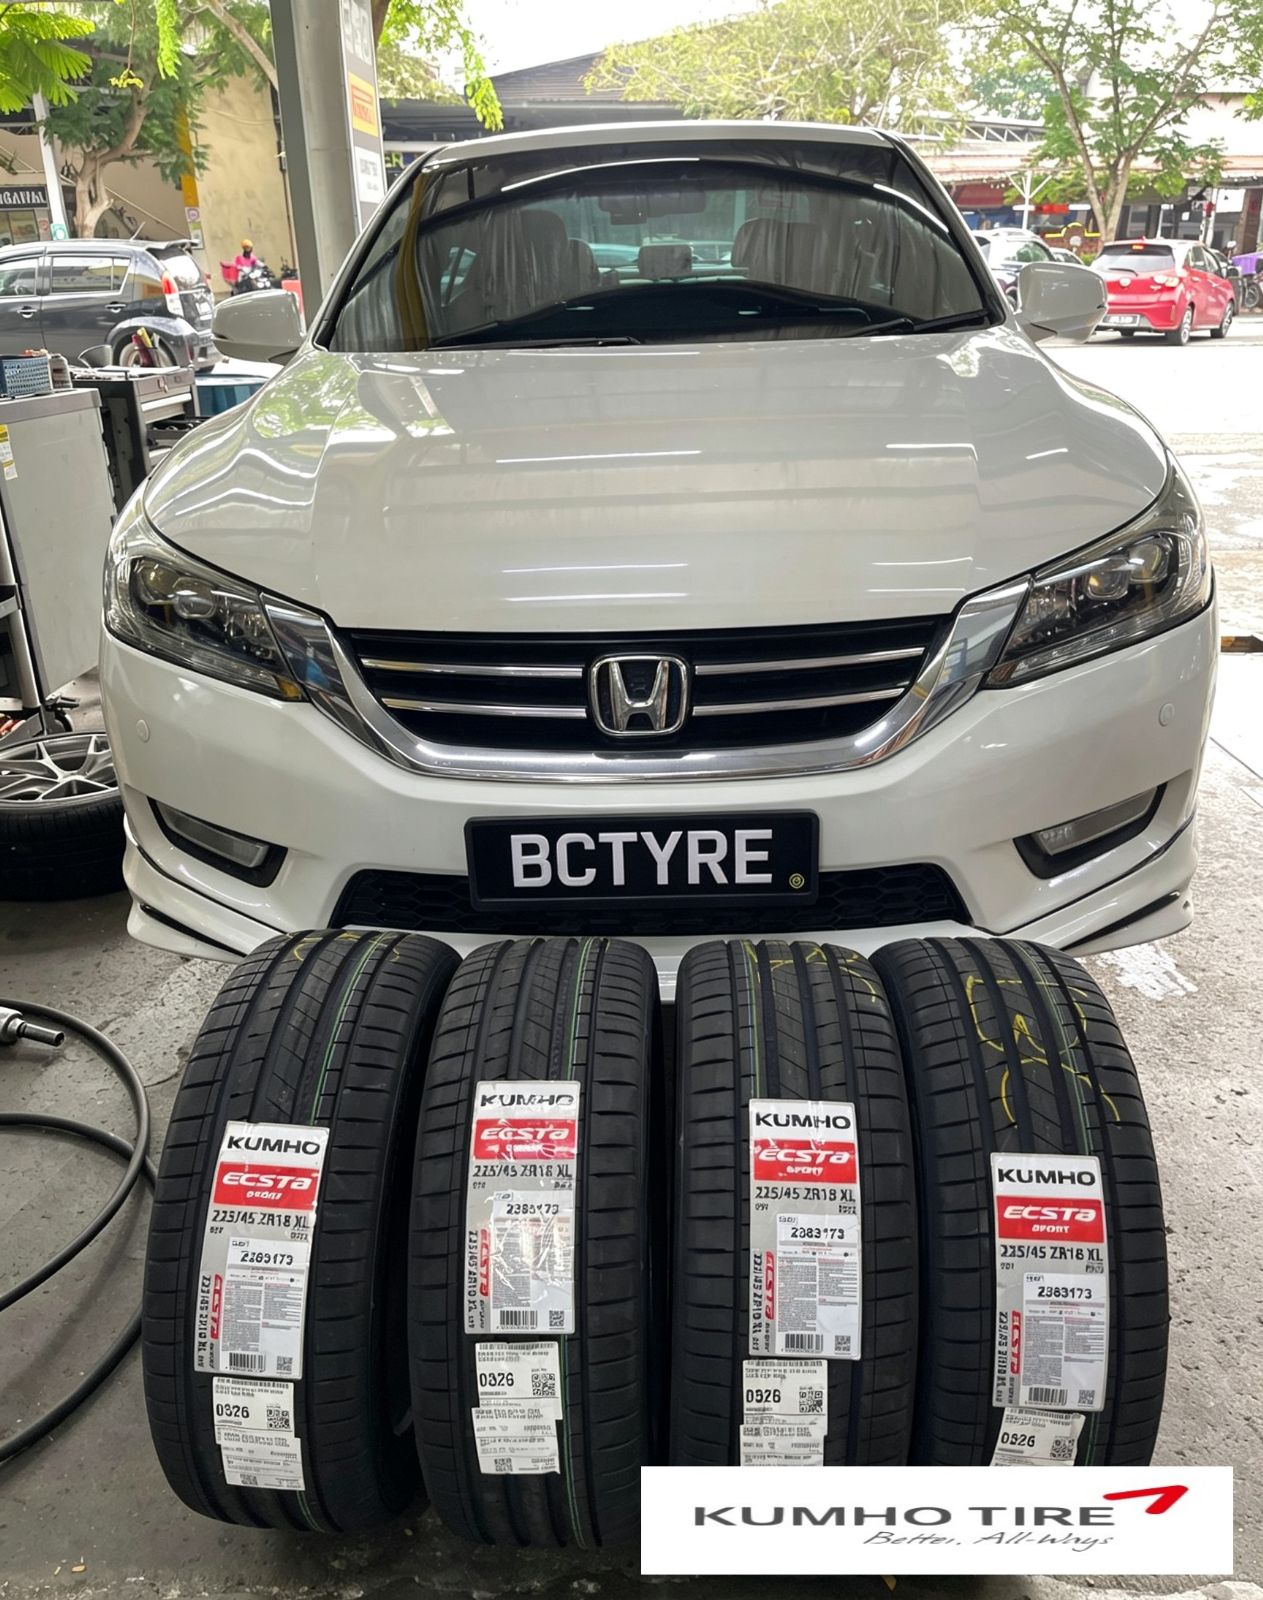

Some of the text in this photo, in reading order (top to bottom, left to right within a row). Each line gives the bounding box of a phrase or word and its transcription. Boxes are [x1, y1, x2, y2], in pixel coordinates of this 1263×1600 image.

[510, 829, 773, 888] BCTYRE
[480, 1094, 574, 1107] KUMHO
[755, 1112, 851, 1129] KUMHO
[227, 1135, 320, 1155] KUMHO
[997, 1168, 1096, 1186] KUMHO
[840, 1188, 856, 1203] XL
[1087, 1247, 1103, 1262] XL
